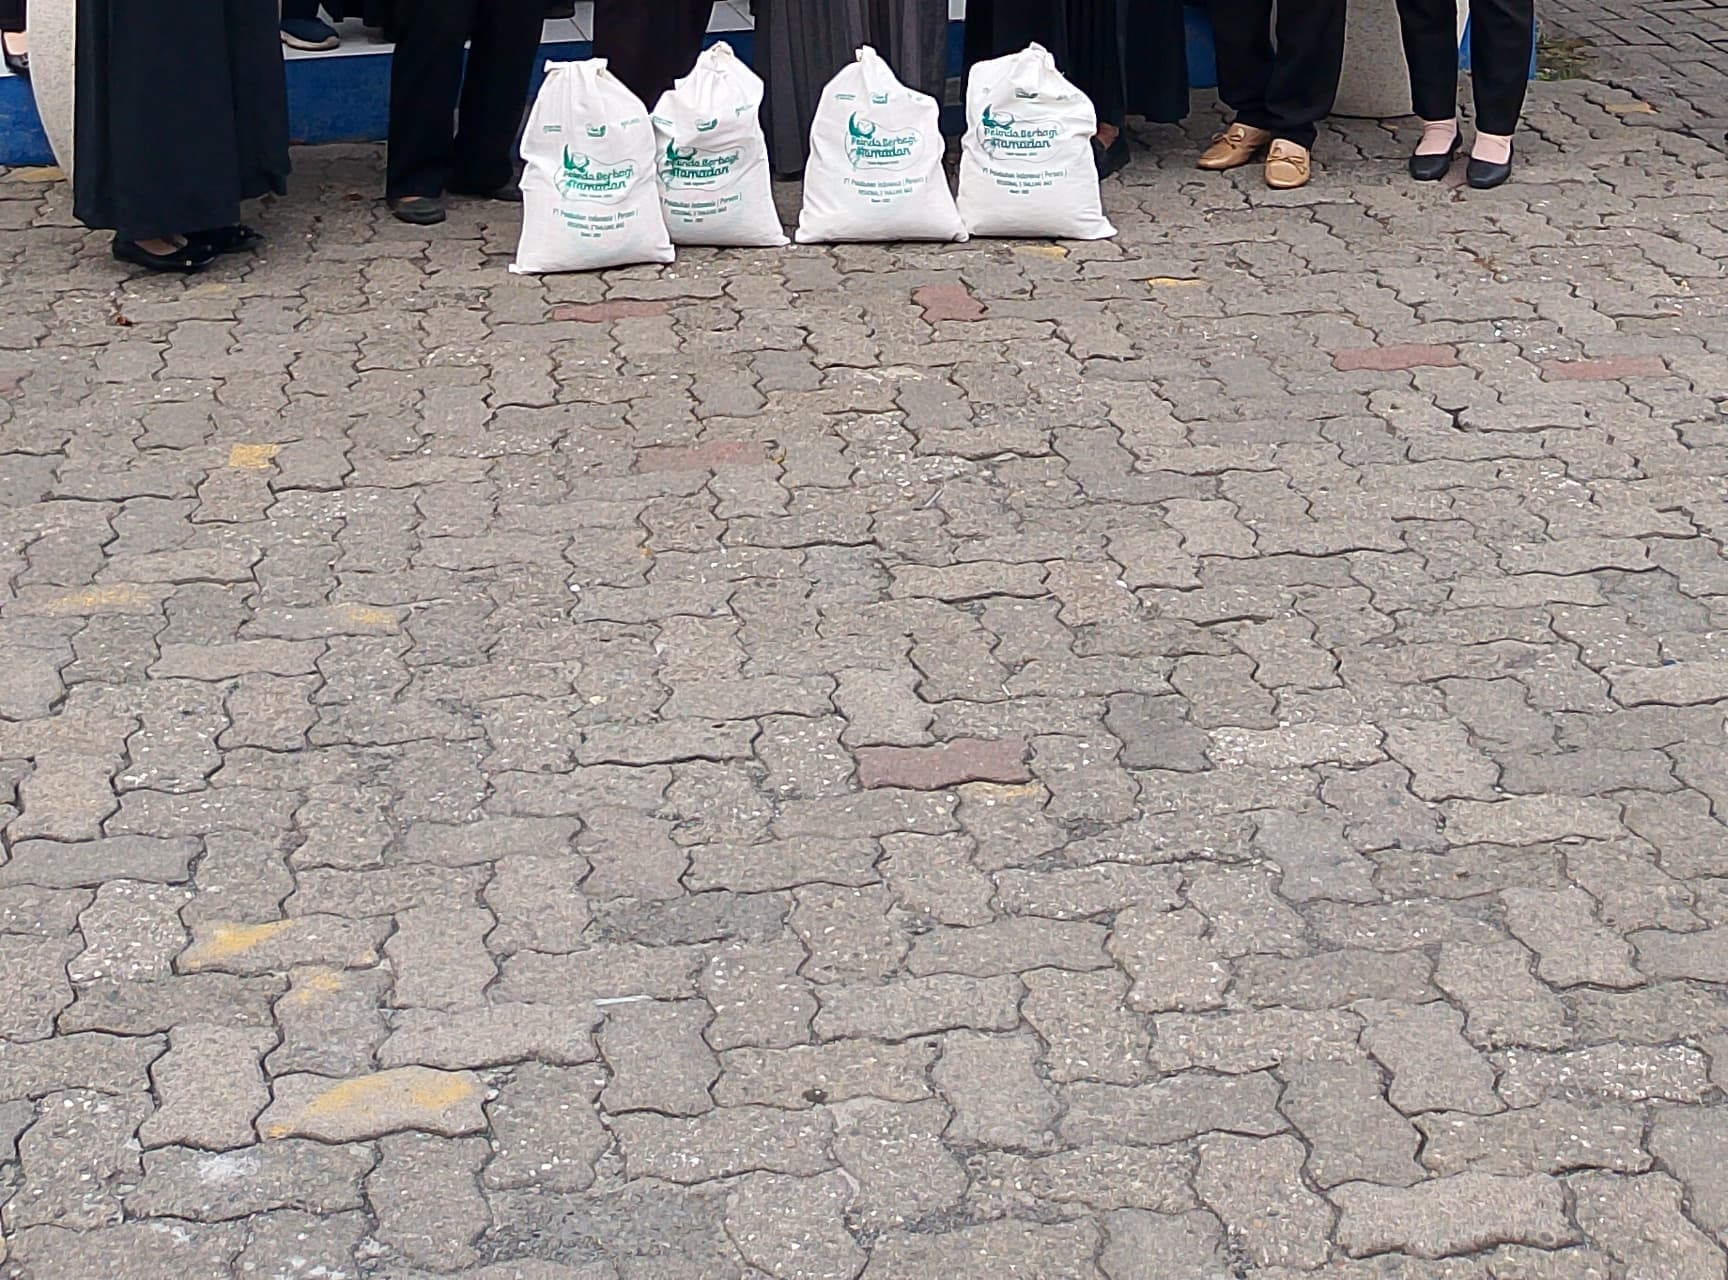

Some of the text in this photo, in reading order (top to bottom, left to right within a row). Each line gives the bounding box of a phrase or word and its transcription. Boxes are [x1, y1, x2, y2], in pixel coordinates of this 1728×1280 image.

[1020, 125, 1059, 139] Berbagi
[991, 139, 1052, 149] Ramadan
[671, 166, 729, 178] Ramadan
